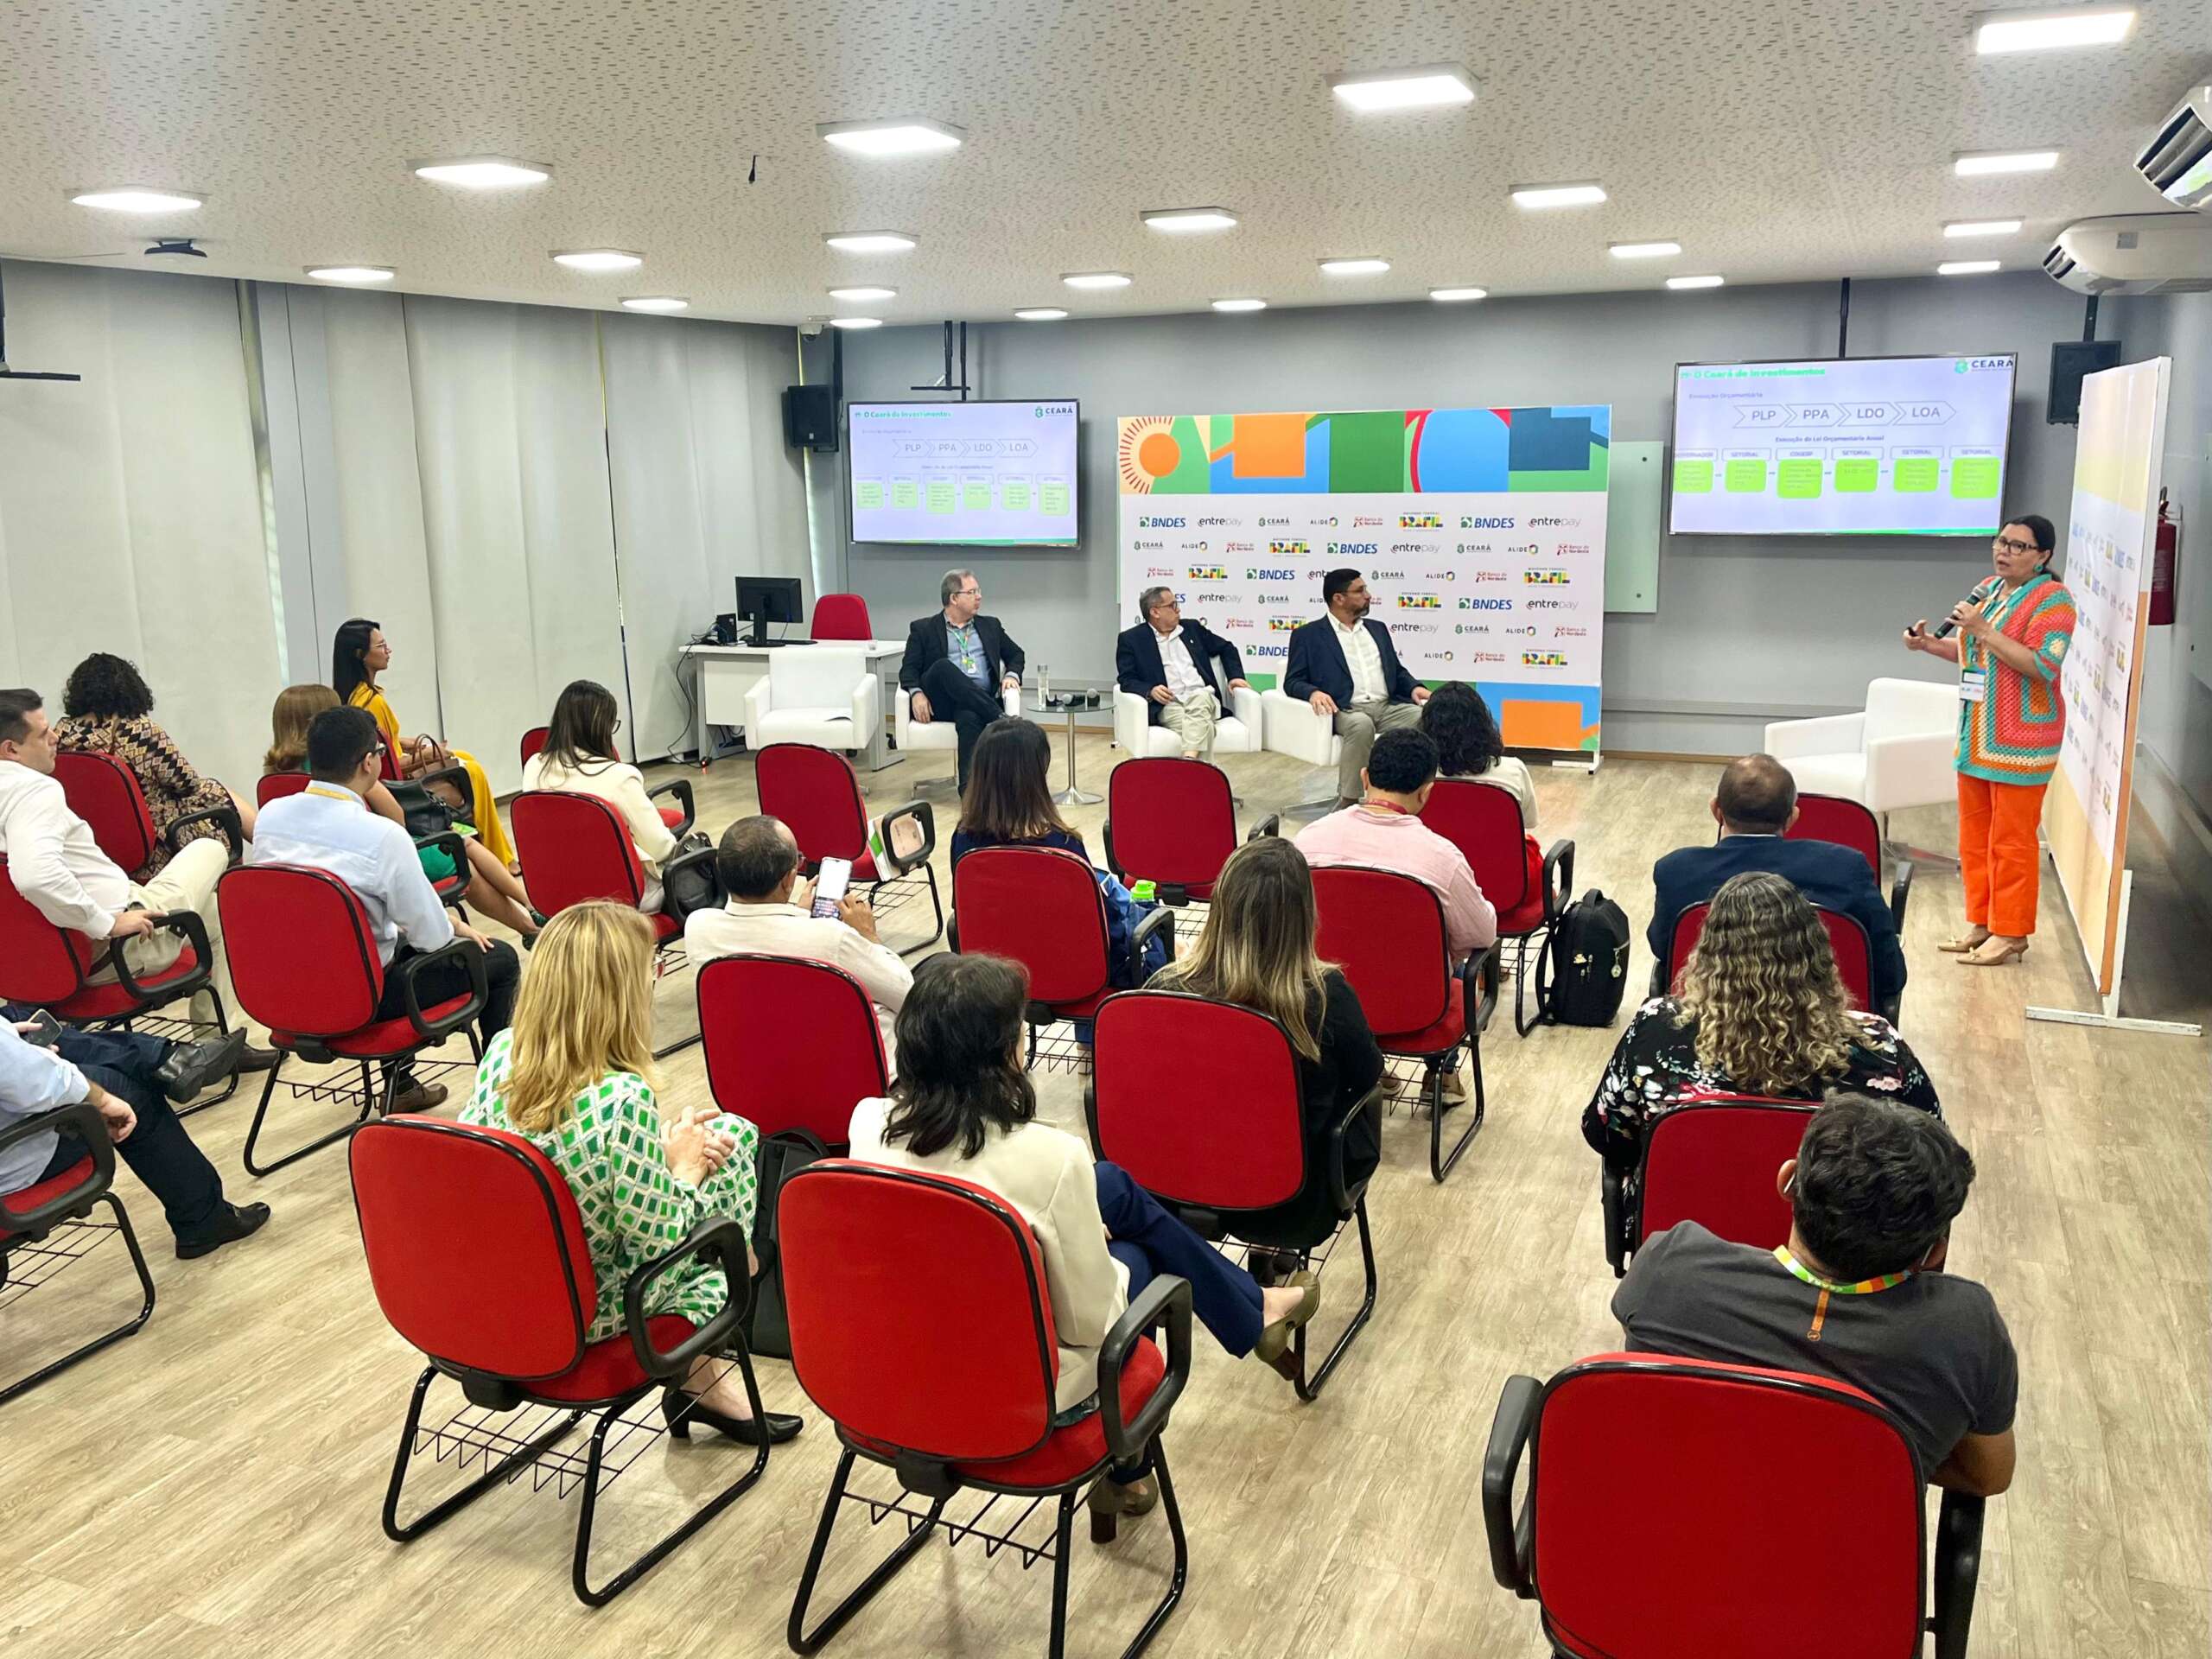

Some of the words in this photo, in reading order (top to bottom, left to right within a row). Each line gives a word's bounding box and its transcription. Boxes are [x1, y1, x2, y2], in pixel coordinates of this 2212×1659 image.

[1751, 410, 1777, 421] PLP
[1802, 410, 1830, 420] PPA
[1857, 408, 1885, 419] LDO
[1912, 407, 1941, 417] LOA
[905, 443, 922, 452] PLP
[974, 443, 993, 452] LDO
[1151, 518, 1186, 528] BNDES
[1198, 517, 1242, 527] entrepay
[1474, 518, 1515, 529] BNDES
[1529, 517, 1581, 527] entrepay
[1340, 543, 1378, 555] BNDES
[1390, 543, 1440, 554] entrepay
[1259, 570, 1294, 580] BNDES
[1198, 593, 1242, 603] entrepay
[1472, 599, 1512, 610] BNDES
[1527, 599, 1578, 610] entrepay
[1390, 622, 1438, 633] entrepay
[1259, 645, 1287, 657] BNDE
